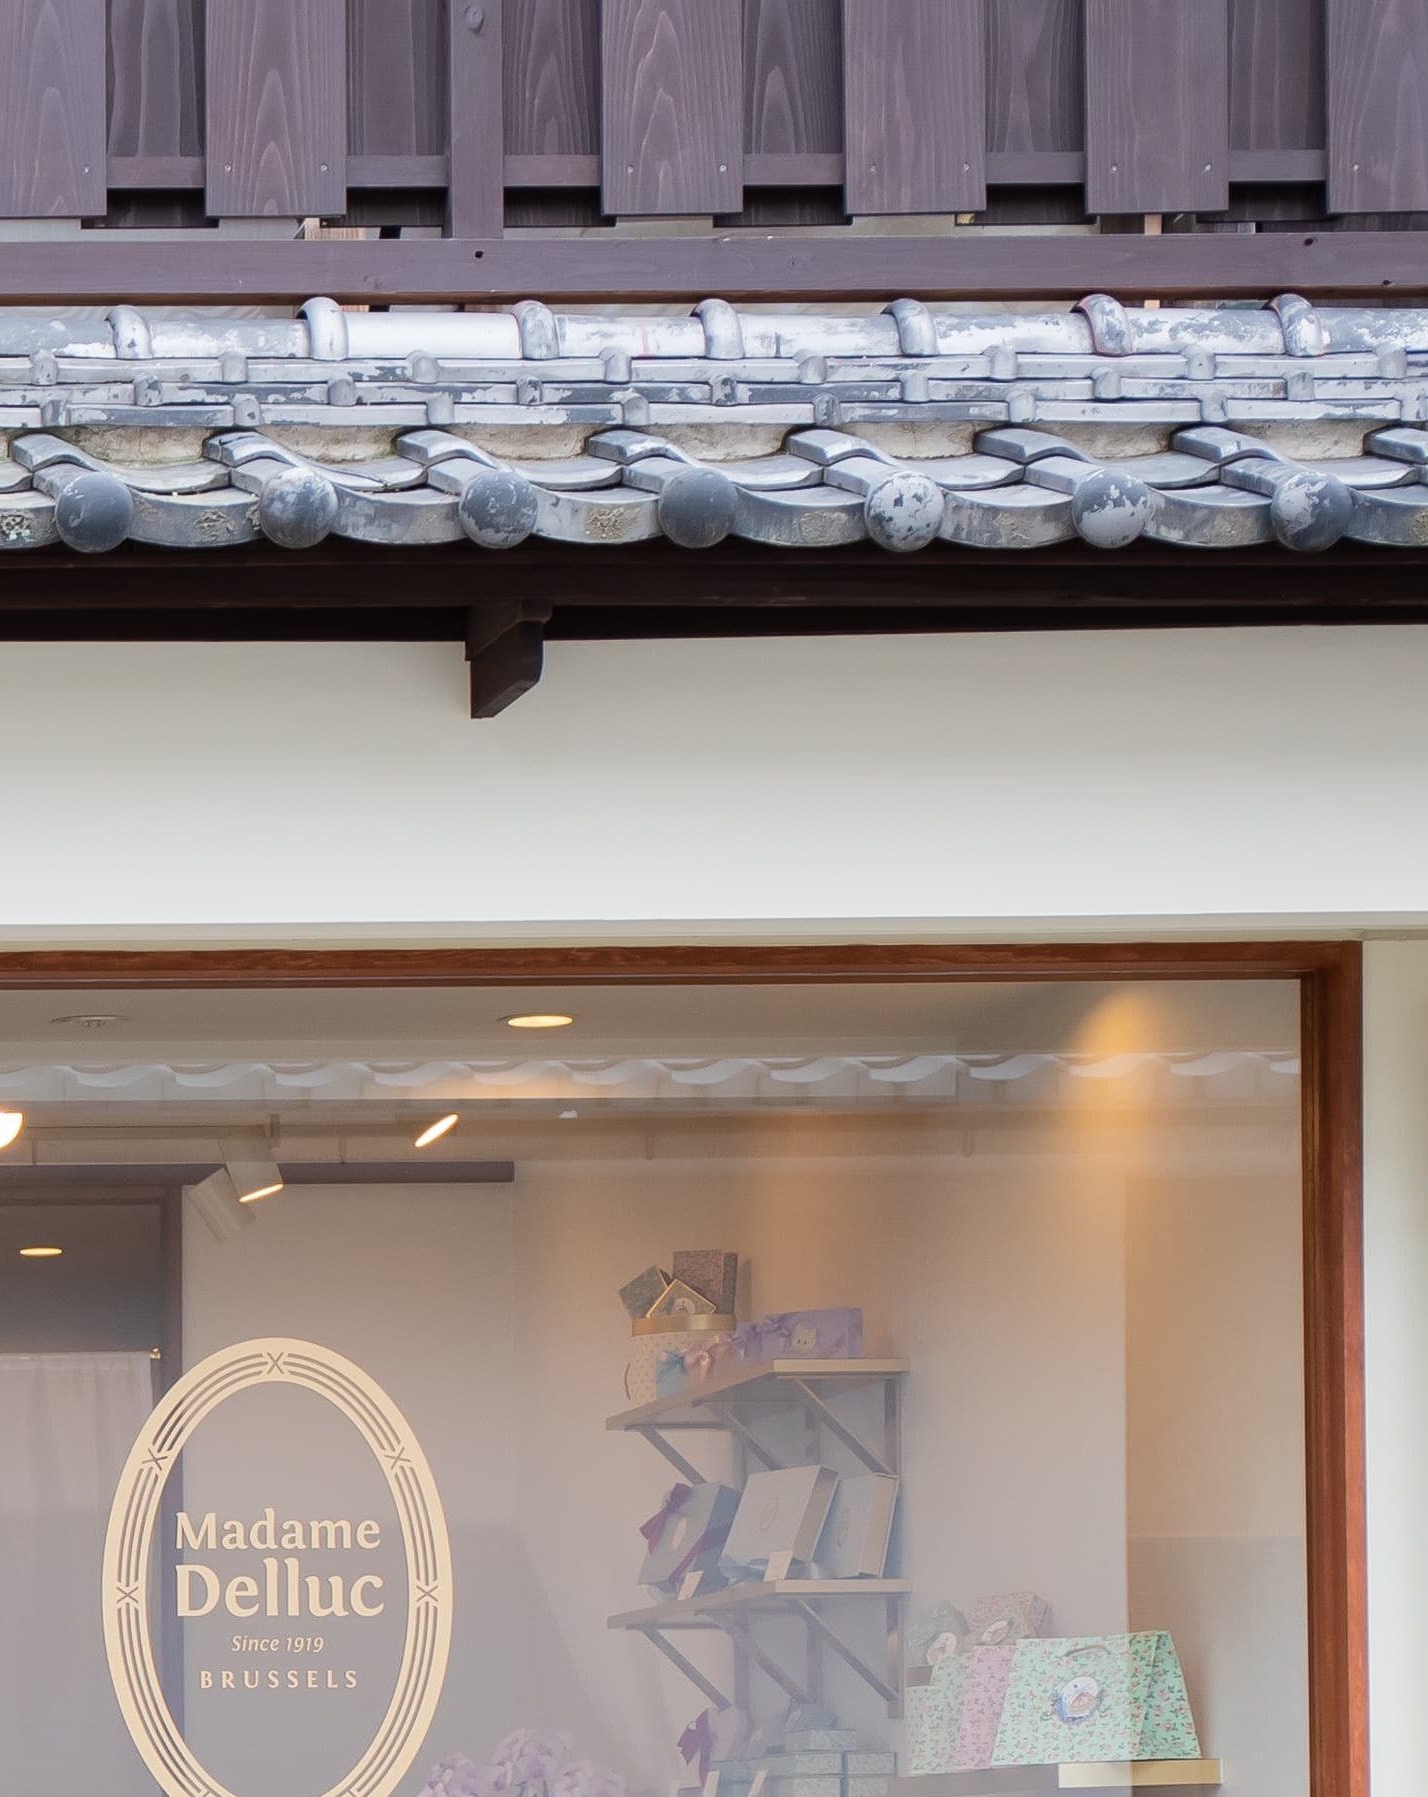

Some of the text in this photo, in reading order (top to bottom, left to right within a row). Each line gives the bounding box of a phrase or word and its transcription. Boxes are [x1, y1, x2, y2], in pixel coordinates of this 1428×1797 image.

[176, 1508, 381, 1549] Madame
[176, 1558, 385, 1617] Delluc
[231, 1634, 325, 1654] Since 1919
[200, 1669, 358, 1689] BRUSSELS
